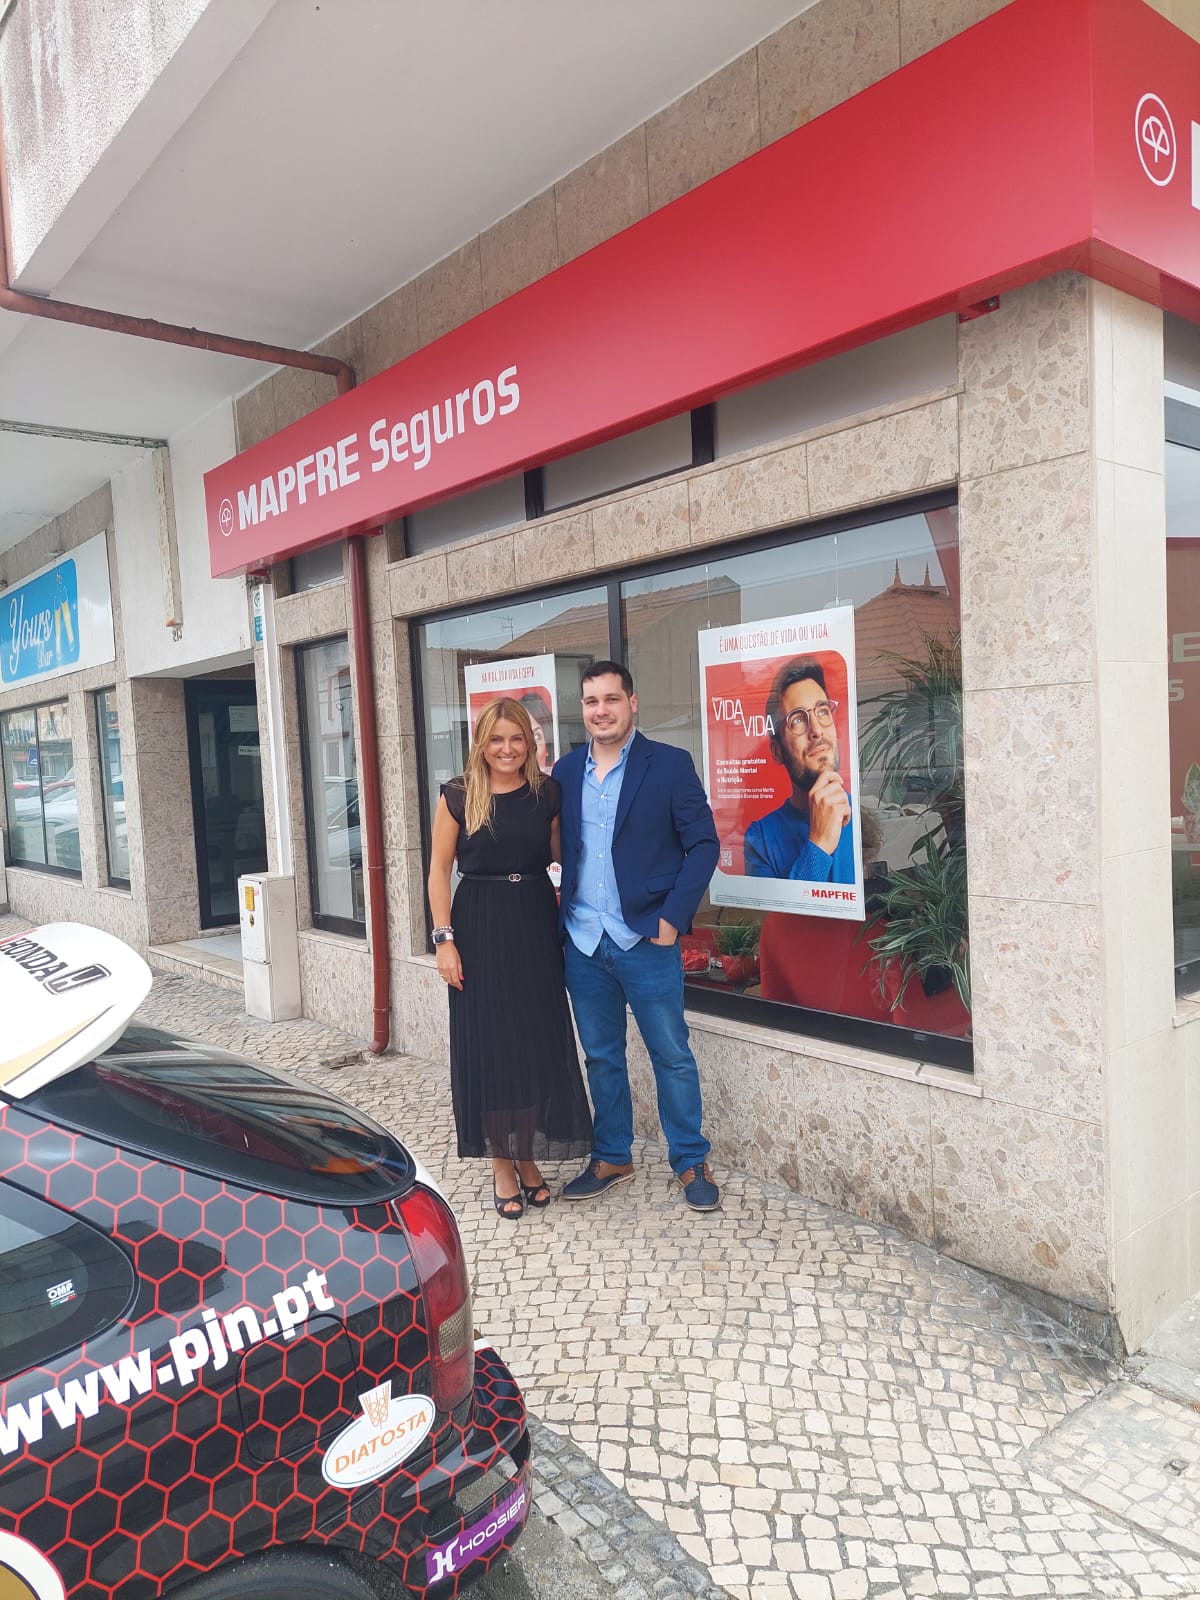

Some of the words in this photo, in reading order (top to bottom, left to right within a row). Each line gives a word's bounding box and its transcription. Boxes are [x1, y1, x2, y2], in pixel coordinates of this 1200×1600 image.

[238, 433, 361, 530] MAPFRE
[369, 365, 520, 472] Seguros
[9, 594, 55, 674] Yours
[724, 636, 739, 652] UMA
[739, 630, 768, 652] QUESTÃO
[770, 631, 780, 645] DE
[780, 627, 798, 644] VIDA
[798, 626, 809, 641] OU
[811, 623, 829, 640] VIDA
[712, 698, 743, 721] VIDA
[742, 714, 776, 737] VIDA
[811, 888, 857, 901] MAPFRE
[0, 938, 68, 982] HONDA
[48, 1282, 73, 1299] OMP
[0, 1268, 335, 1455] www.pjn.pt
[335, 1410, 427, 1474] DIATOSTA
[459, 1493, 526, 1557] HOOSIER
